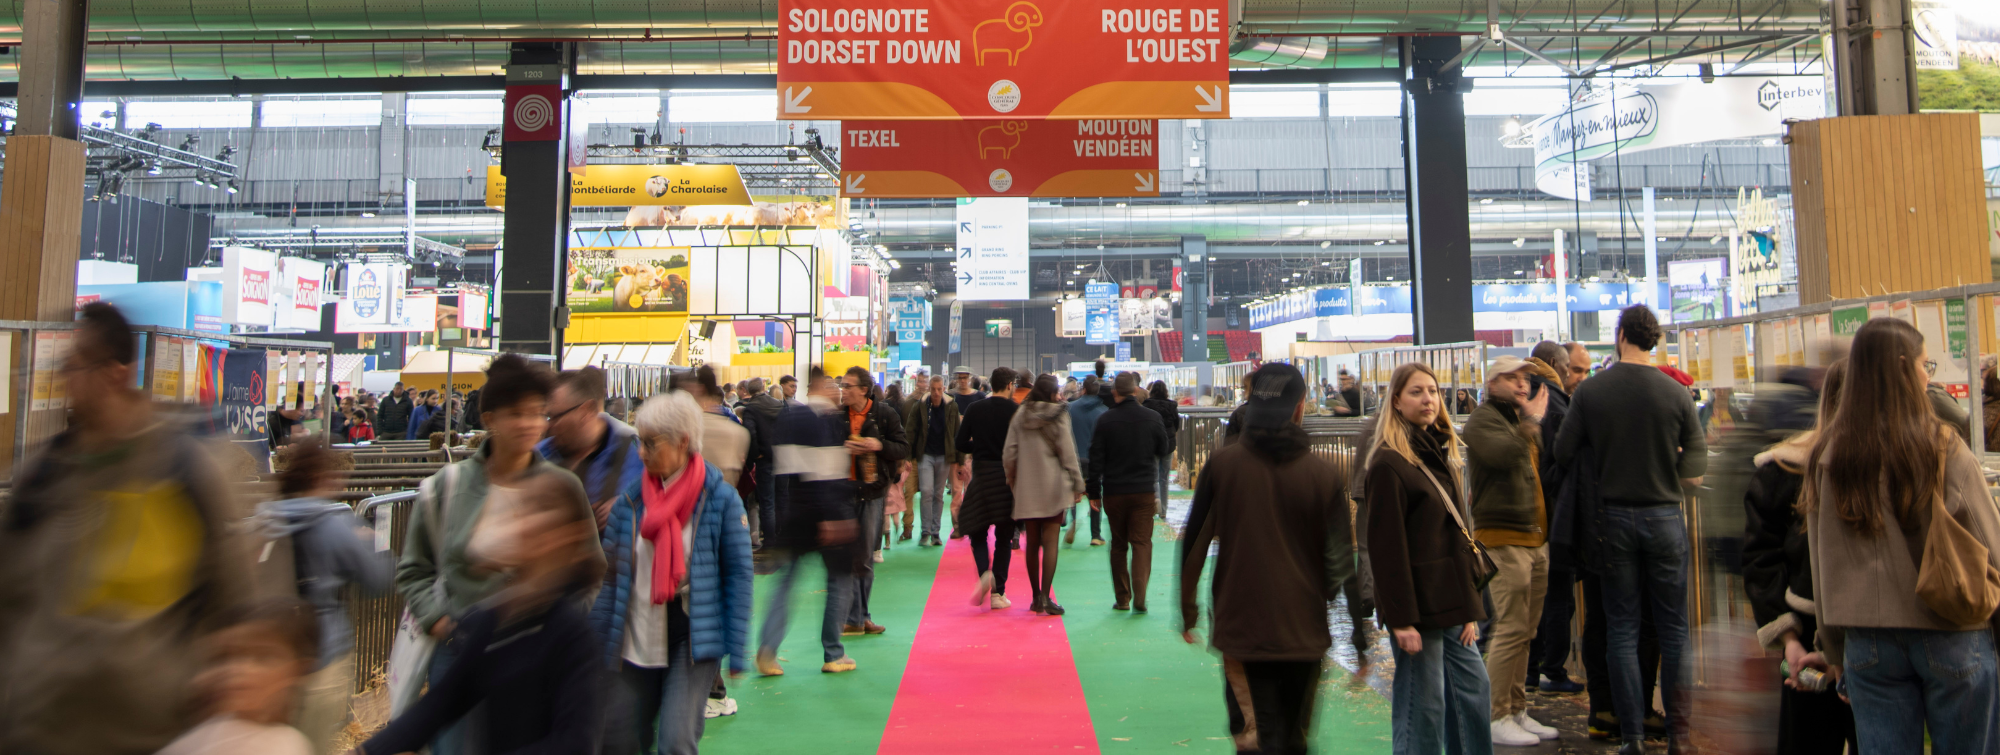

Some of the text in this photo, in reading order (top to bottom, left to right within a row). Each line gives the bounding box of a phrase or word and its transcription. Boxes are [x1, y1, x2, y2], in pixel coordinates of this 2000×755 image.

[788, 9, 929, 33] SOLOGNOTE
[1101, 9, 1219, 33] ROUGE DE
[788, 39, 961, 64] DORSET DOWN
[1126, 38, 1220, 63] L'OUEST
[1763, 86, 1822, 101] interbev
[1078, 119, 1152, 136] MOUTON
[848, 130, 900, 148] TEXEL
[1073, 135, 1152, 157] VENDÉEN
[670, 184, 728, 194] Charolaise
[1319, 297, 1347, 311] produits
[1498, 293, 1537, 307] produits
